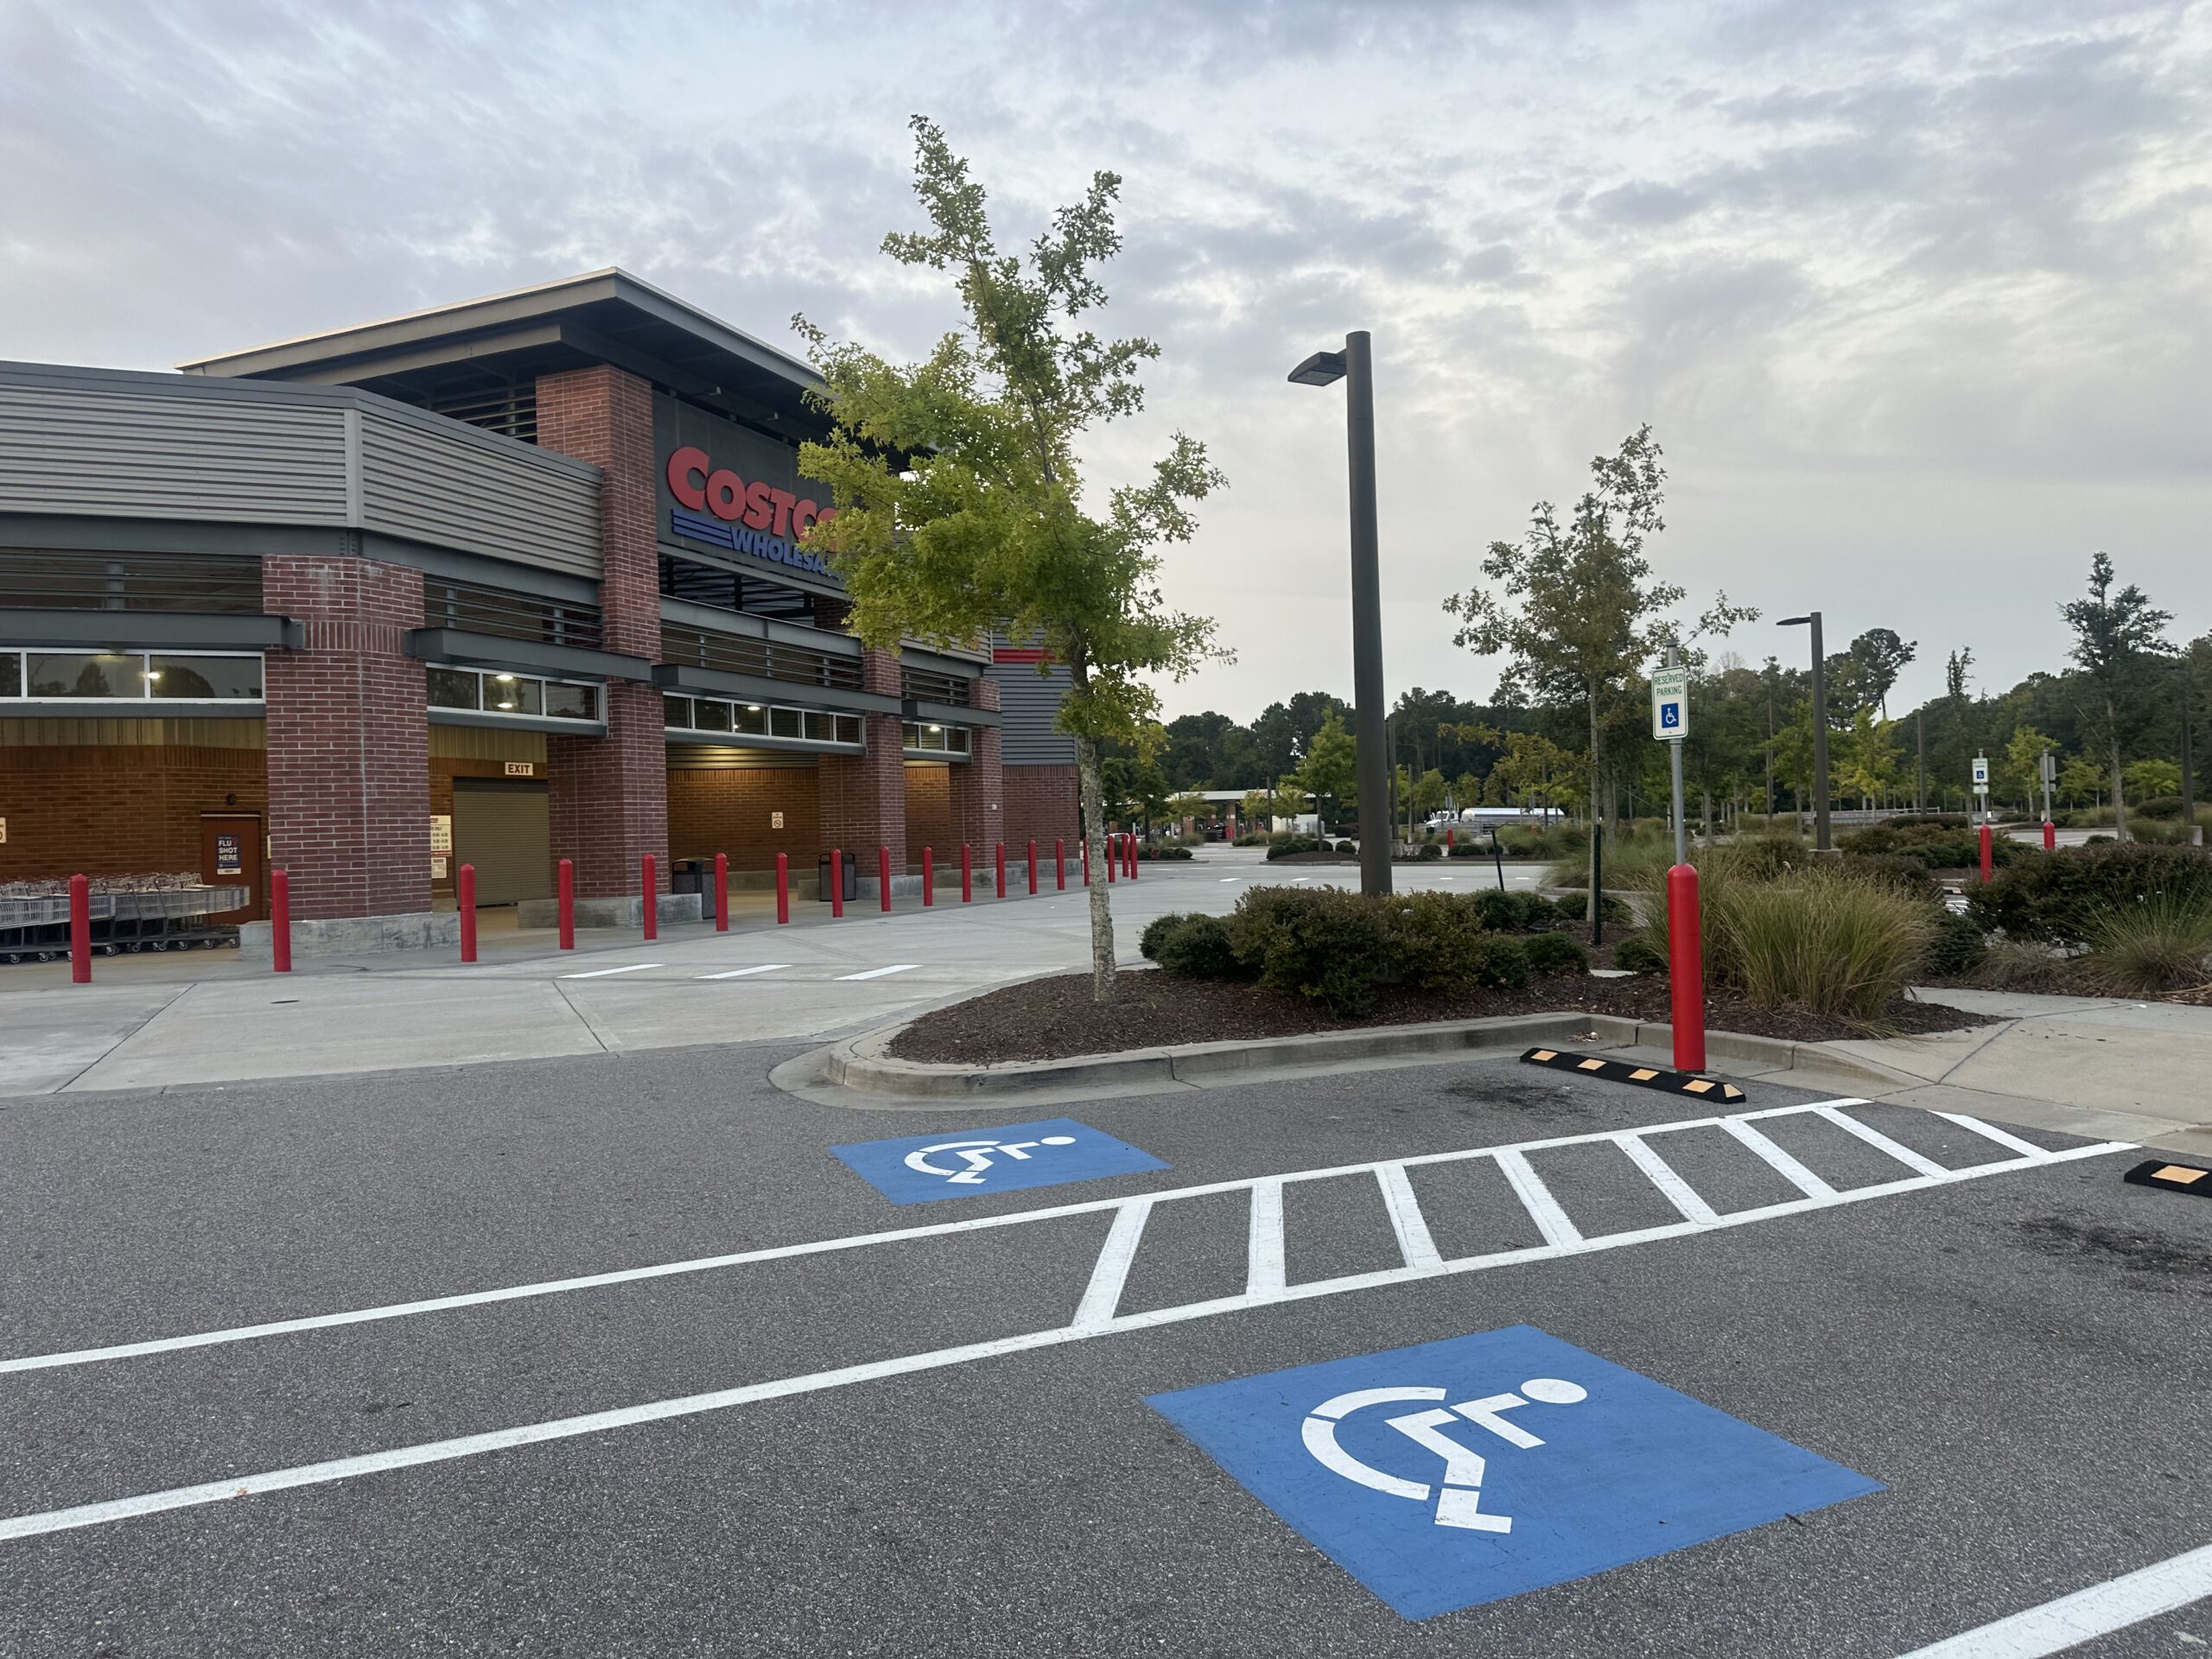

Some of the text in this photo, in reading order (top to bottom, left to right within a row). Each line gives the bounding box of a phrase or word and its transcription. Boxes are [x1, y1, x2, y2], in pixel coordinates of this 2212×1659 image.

[1654, 674, 1683, 685] RESERVED
[1656, 686, 1682, 696] PARKING
[508, 764, 530, 774] EXIT
